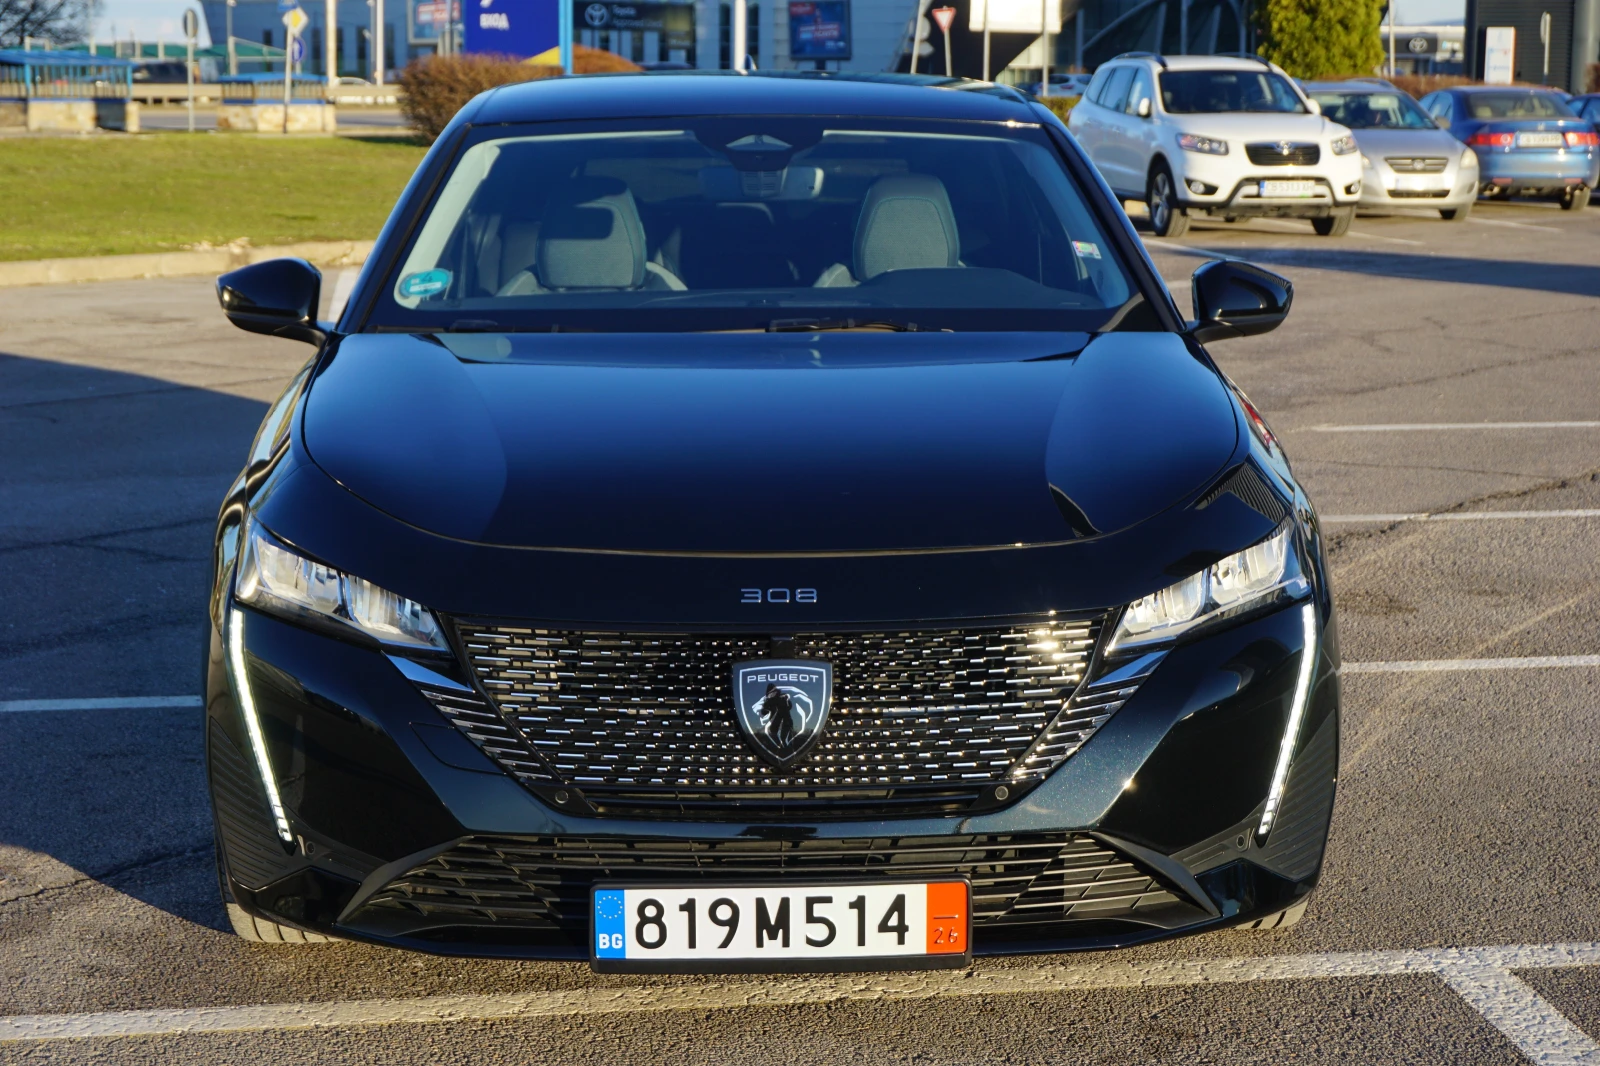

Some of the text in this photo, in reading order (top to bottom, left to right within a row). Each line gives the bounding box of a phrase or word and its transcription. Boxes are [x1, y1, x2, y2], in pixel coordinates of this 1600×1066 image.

[741, 588, 817, 603] 308
[747, 673, 819, 683] PEUGEOT
[635, 893, 910, 949] 819M514
[598, 933, 623, 949] BG
[934, 926, 959, 944] 26
